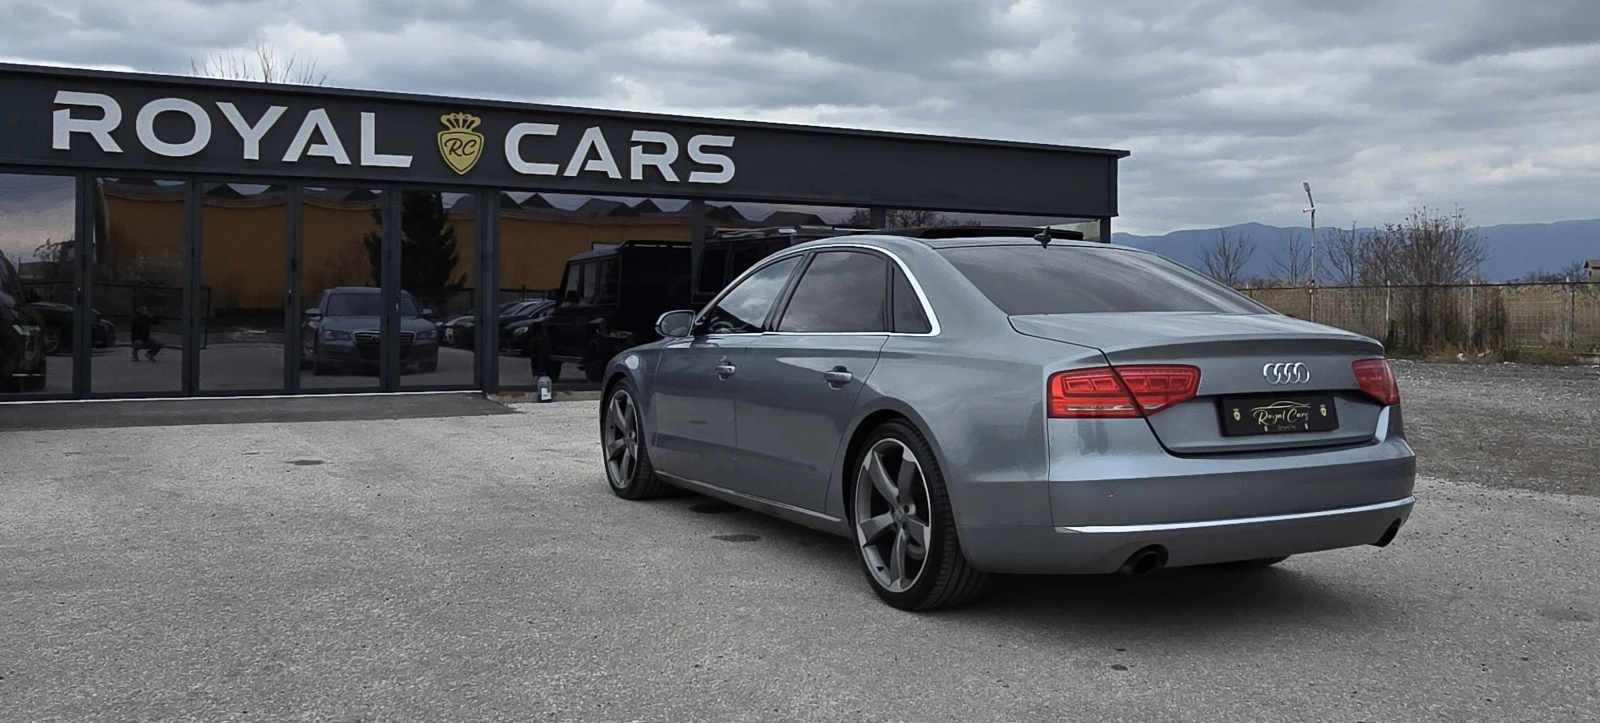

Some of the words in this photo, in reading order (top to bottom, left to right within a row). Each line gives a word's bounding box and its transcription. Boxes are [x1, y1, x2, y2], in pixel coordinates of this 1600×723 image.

[52, 90, 413, 168] ROYAL
[504, 122, 736, 184] CARS
[444, 137, 477, 157] RC
[1252, 409, 1286, 425] Royal
[1286, 408, 1309, 423] Cars
